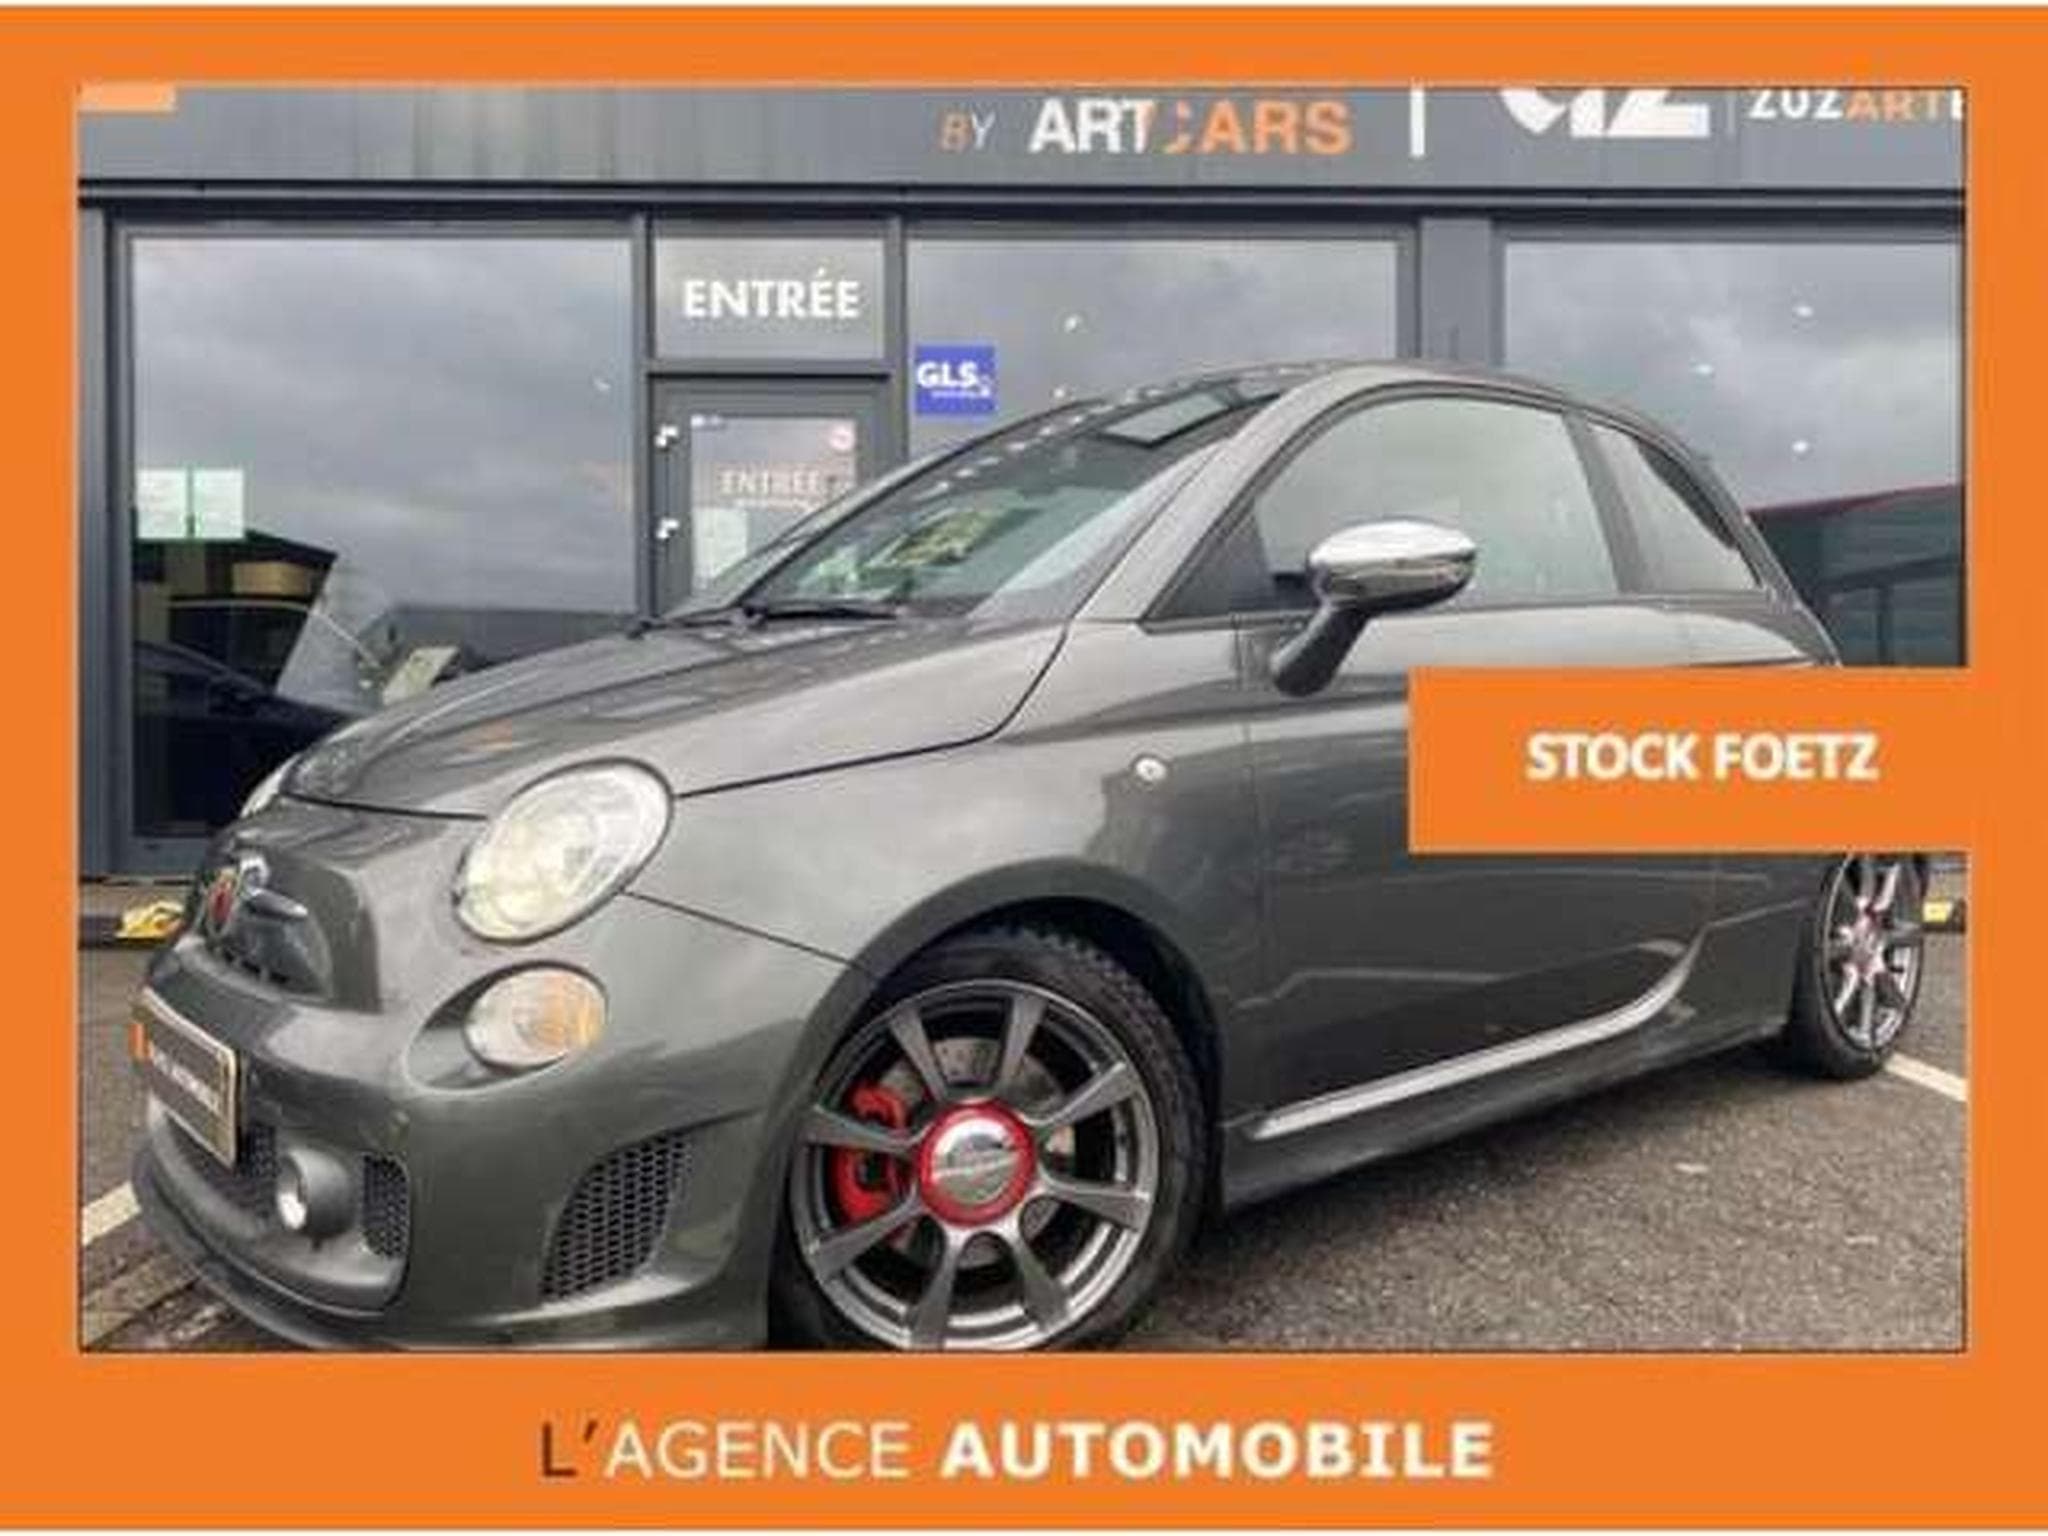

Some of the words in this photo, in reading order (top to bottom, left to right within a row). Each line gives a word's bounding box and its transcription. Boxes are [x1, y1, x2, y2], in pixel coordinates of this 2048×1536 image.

[1748, 87, 1963, 119] ZUZART
[940, 109, 996, 152] BY
[683, 266, 860, 319] ENTRÉE
[916, 360, 978, 389] GLS
